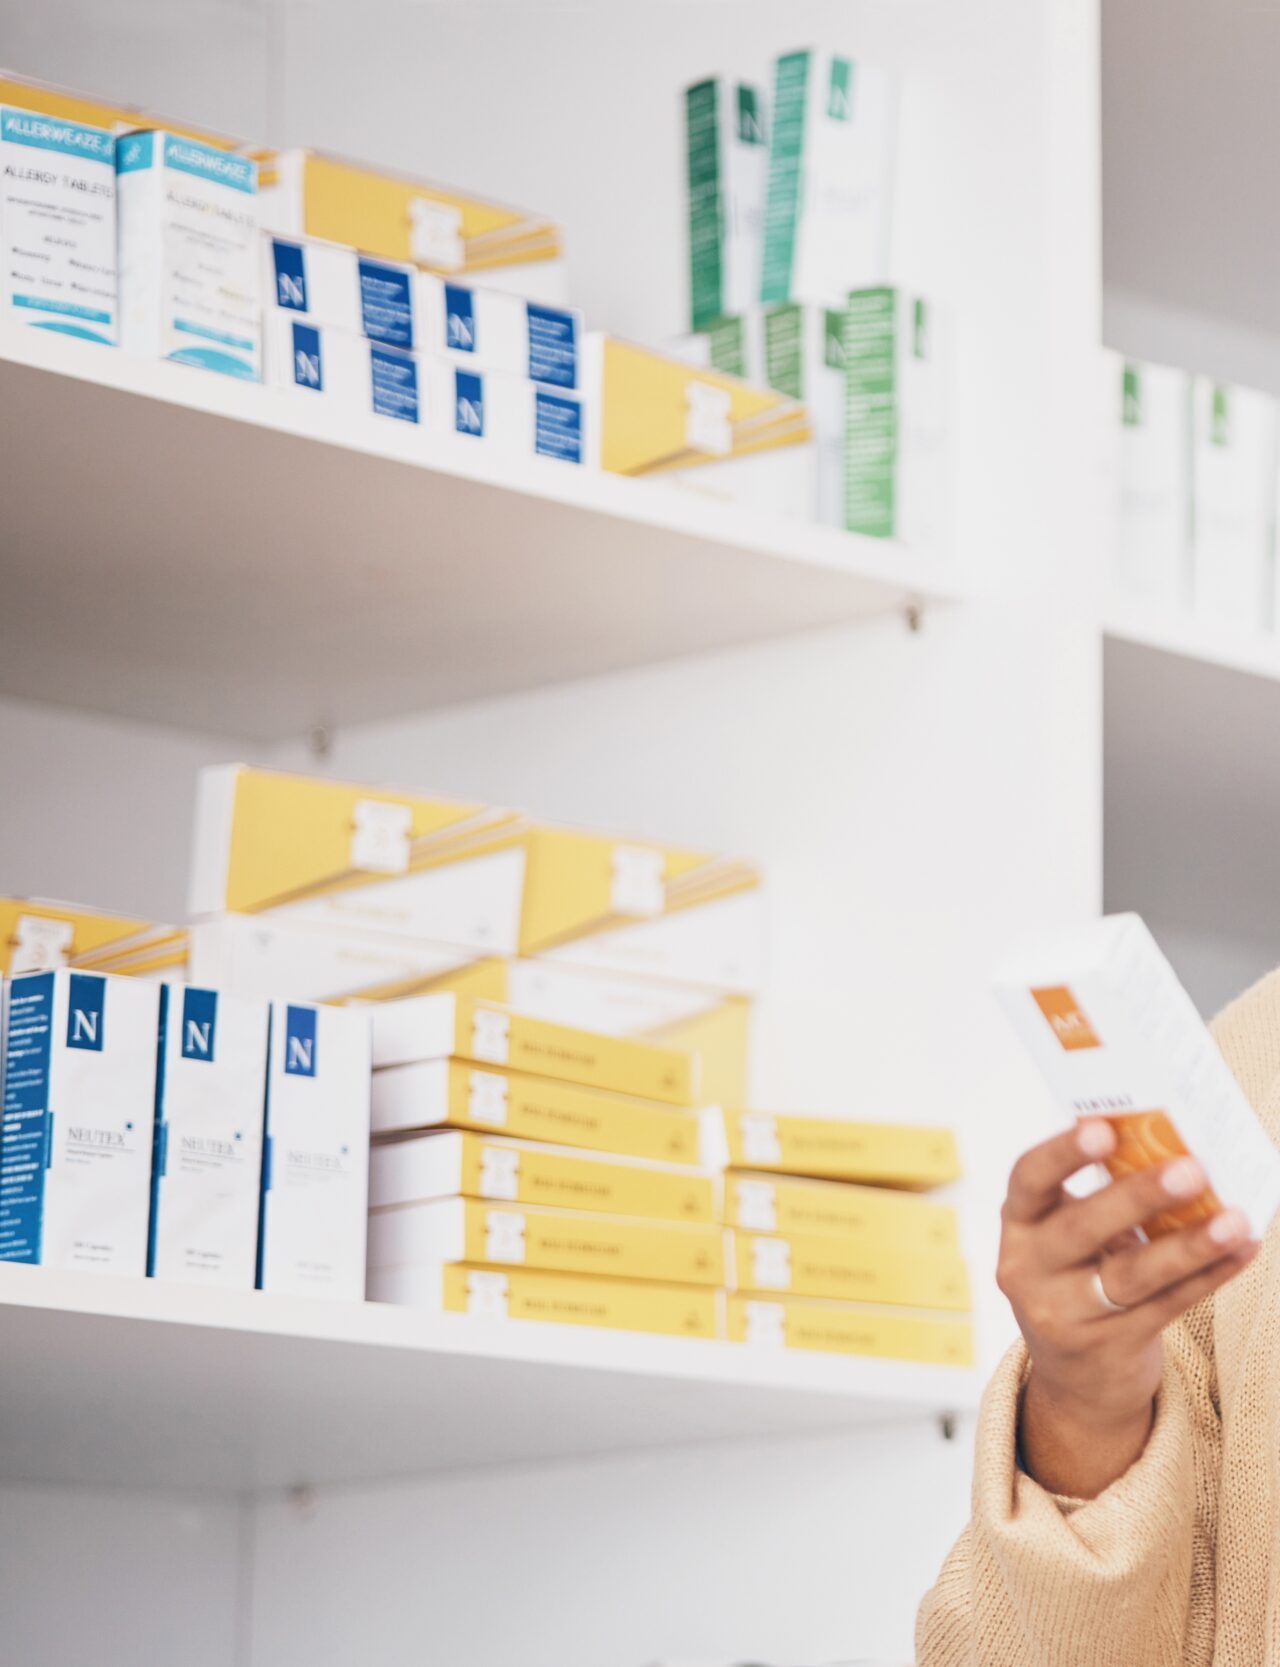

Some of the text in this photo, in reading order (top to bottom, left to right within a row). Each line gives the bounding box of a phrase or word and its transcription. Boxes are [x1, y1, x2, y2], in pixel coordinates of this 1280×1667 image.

[4, 165, 114, 199] ALLERGY TABLETS
[278, 271, 304, 306] N
[447, 312, 473, 349] N
[296, 350, 319, 385] N
[458, 397, 481, 431] N
[72, 1008, 98, 1042] N
[185, 1019, 211, 1053] N
[287, 1035, 313, 1071] N
[68, 1127, 125, 1146] NEUTEX
[181, 1137, 236, 1156] NEUTEX
